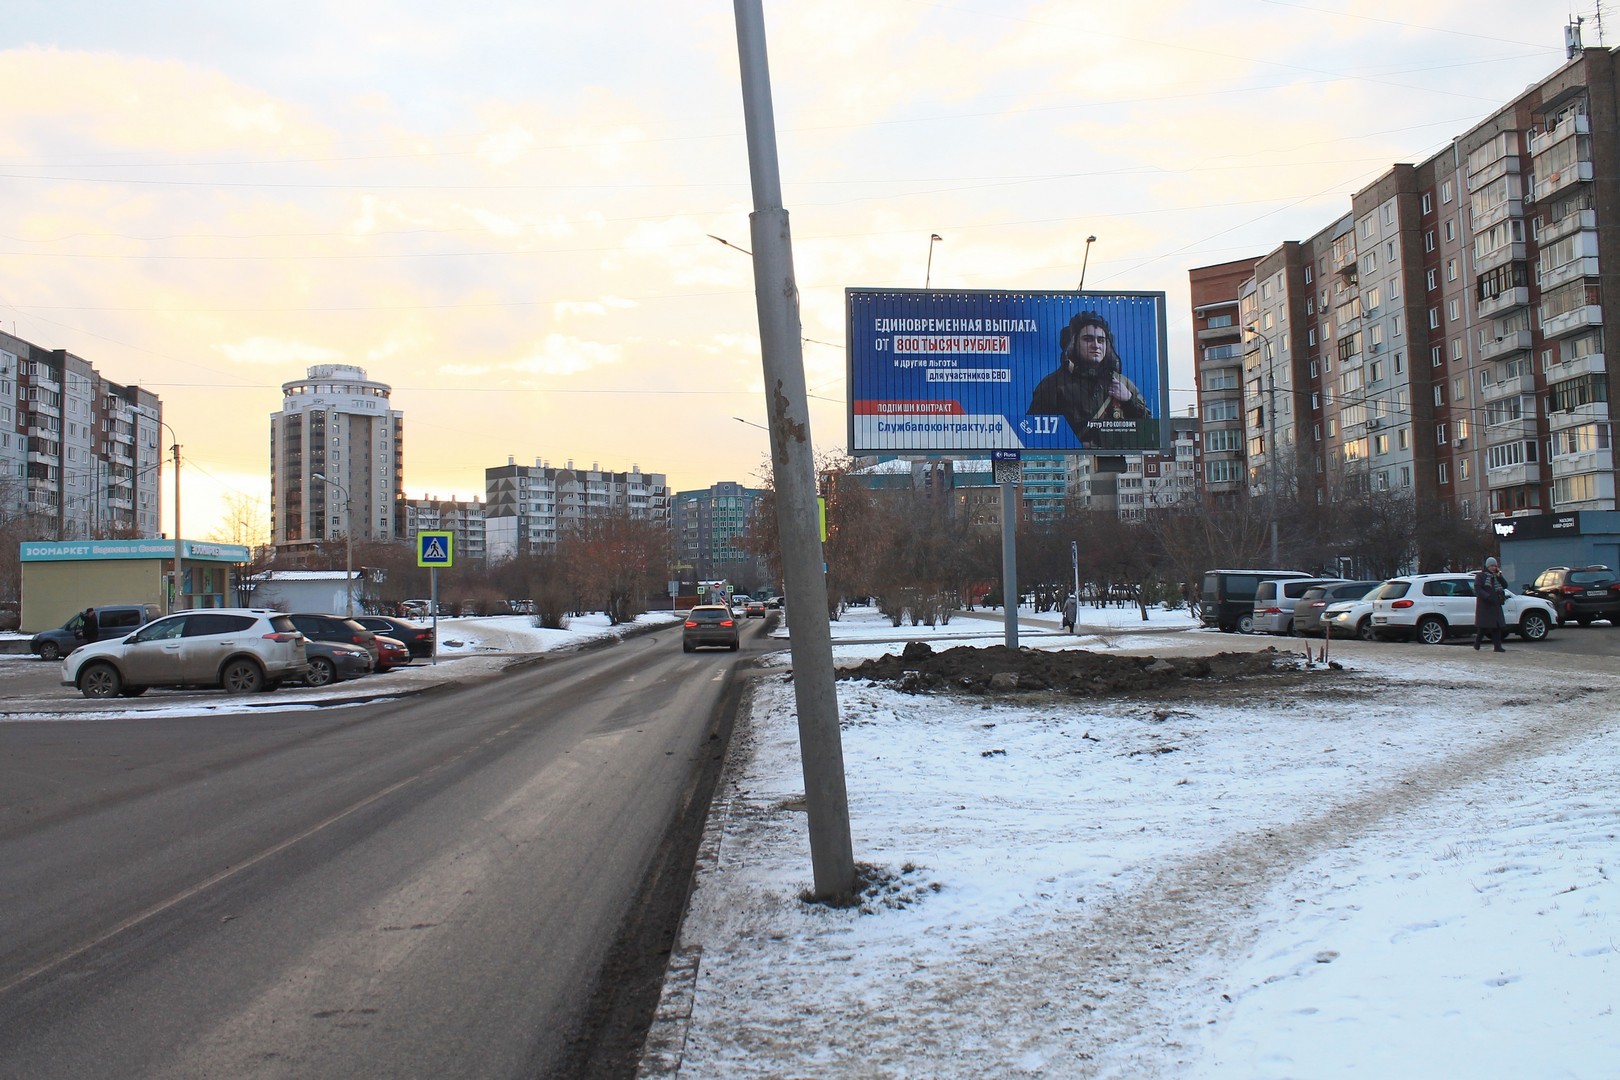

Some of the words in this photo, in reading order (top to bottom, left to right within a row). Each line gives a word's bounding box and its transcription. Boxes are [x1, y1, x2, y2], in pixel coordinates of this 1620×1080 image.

[874, 318, 982, 332] ЕДИНОВРЕМЕННАЯ
[985, 319, 1037, 332] ВЫПЛАТА
[875, 338, 889, 351] ОТ
[896, 338, 919, 351] 800
[921, 338, 960, 351] ТЫСЯЧ
[963, 335, 1007, 352] РУБЛЕЙ
[900, 360, 927, 369] другие
[929, 360, 957, 368] льготы
[929, 372, 944, 381] для
[945, 372, 990, 382] участников
[991, 371, 1006, 380] СВО
[877, 403, 915, 413] ПОДПИШИ
[916, 403, 952, 413] КОНТРАКТ
[878, 421, 1003, 434] Службапоконтракту.рф
[1034, 416, 1058, 434] 117
[1494, 523, 1514, 537] Vape
[26, 546, 90, 556] ЗООМАРКЕТ
